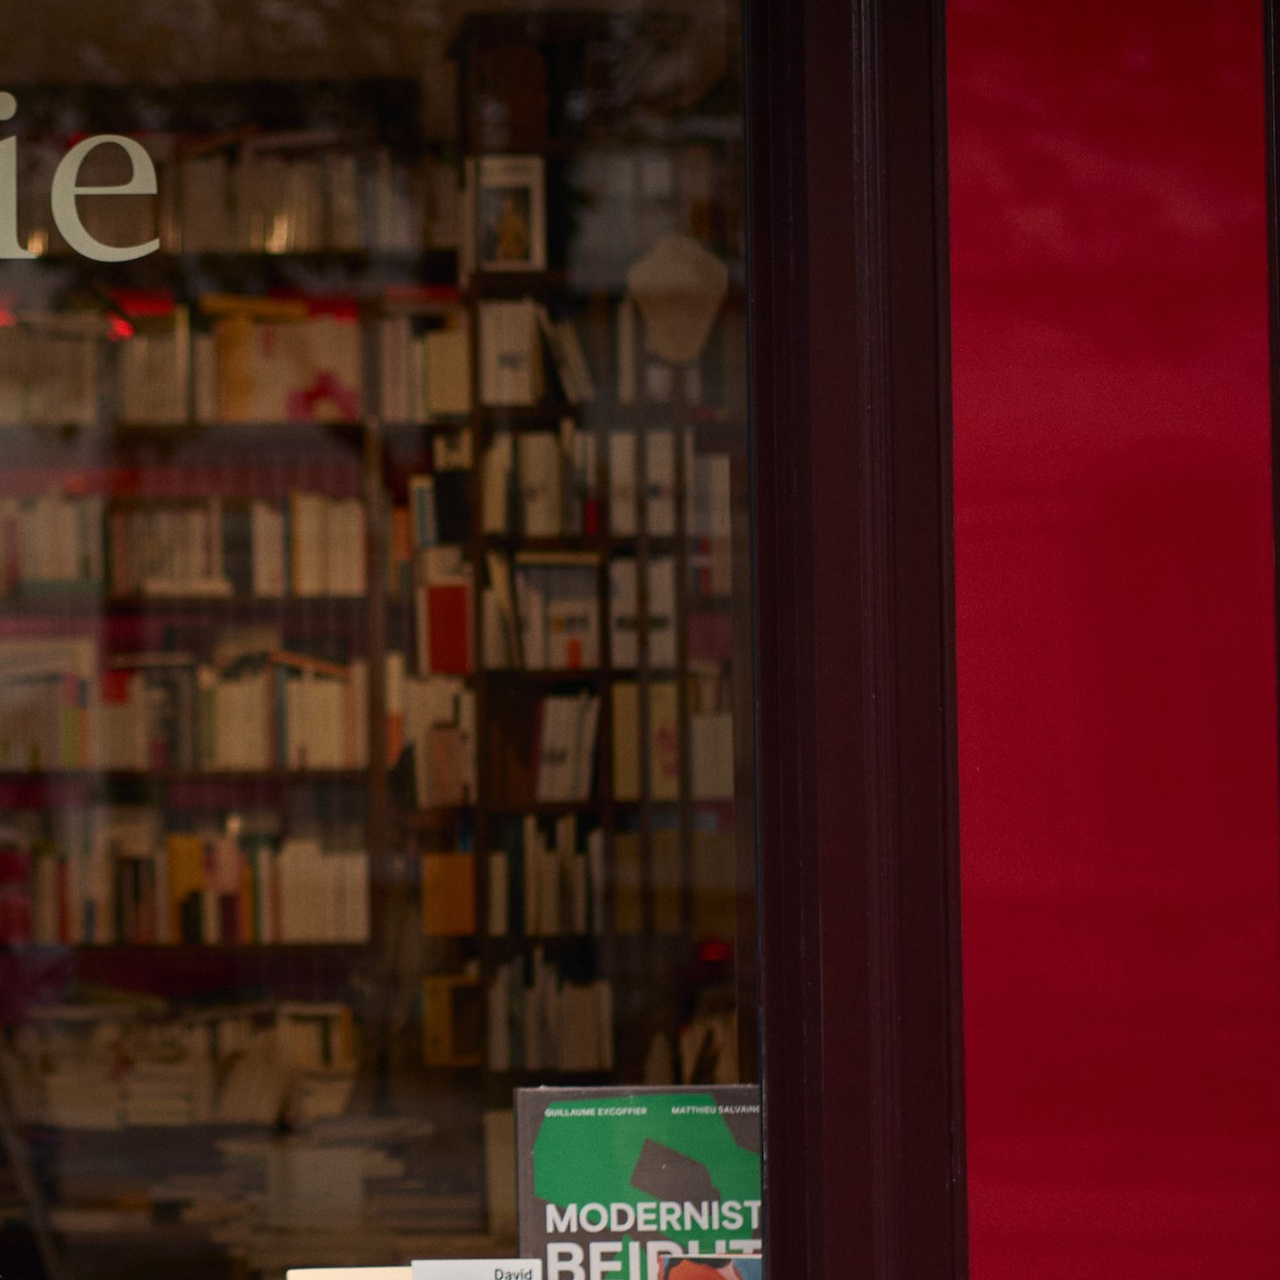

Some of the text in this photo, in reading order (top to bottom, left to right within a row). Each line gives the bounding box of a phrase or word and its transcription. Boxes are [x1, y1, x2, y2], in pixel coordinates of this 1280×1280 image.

[545, 1107, 596, 1117] GUILLAUME
[671, 1105, 717, 1115] MATTHIEU
[545, 1200, 762, 1234] MODERNIST
[494, 1268, 533, 1280] David
